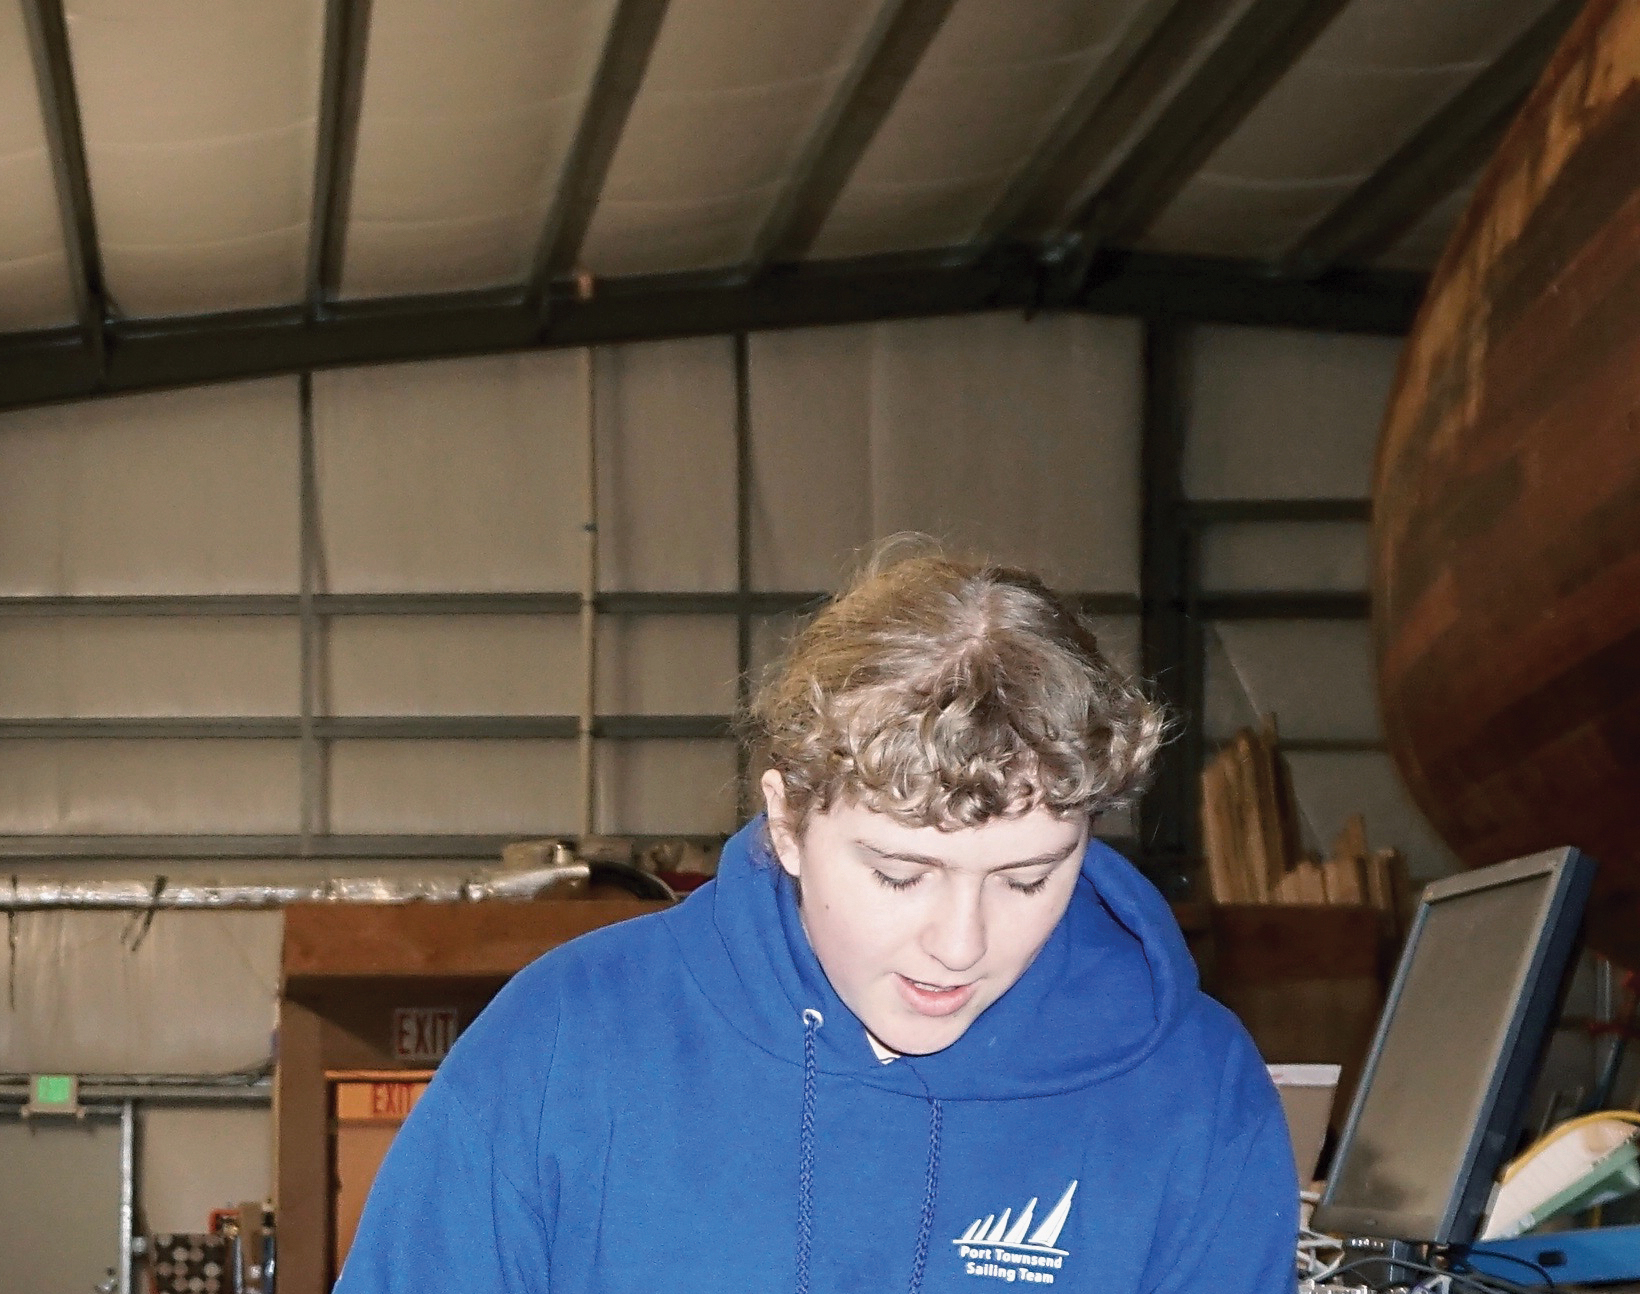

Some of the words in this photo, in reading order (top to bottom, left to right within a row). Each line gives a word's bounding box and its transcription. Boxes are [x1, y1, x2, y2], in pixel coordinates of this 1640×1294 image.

[398, 1013, 453, 1055] EXIT
[373, 1083, 415, 1113] EXIT
[960, 1245, 992, 1260] Port
[995, 1249, 1062, 1269] Townsend
[966, 1262, 1016, 1282] Sailing
[1019, 1268, 1054, 1284] Team
